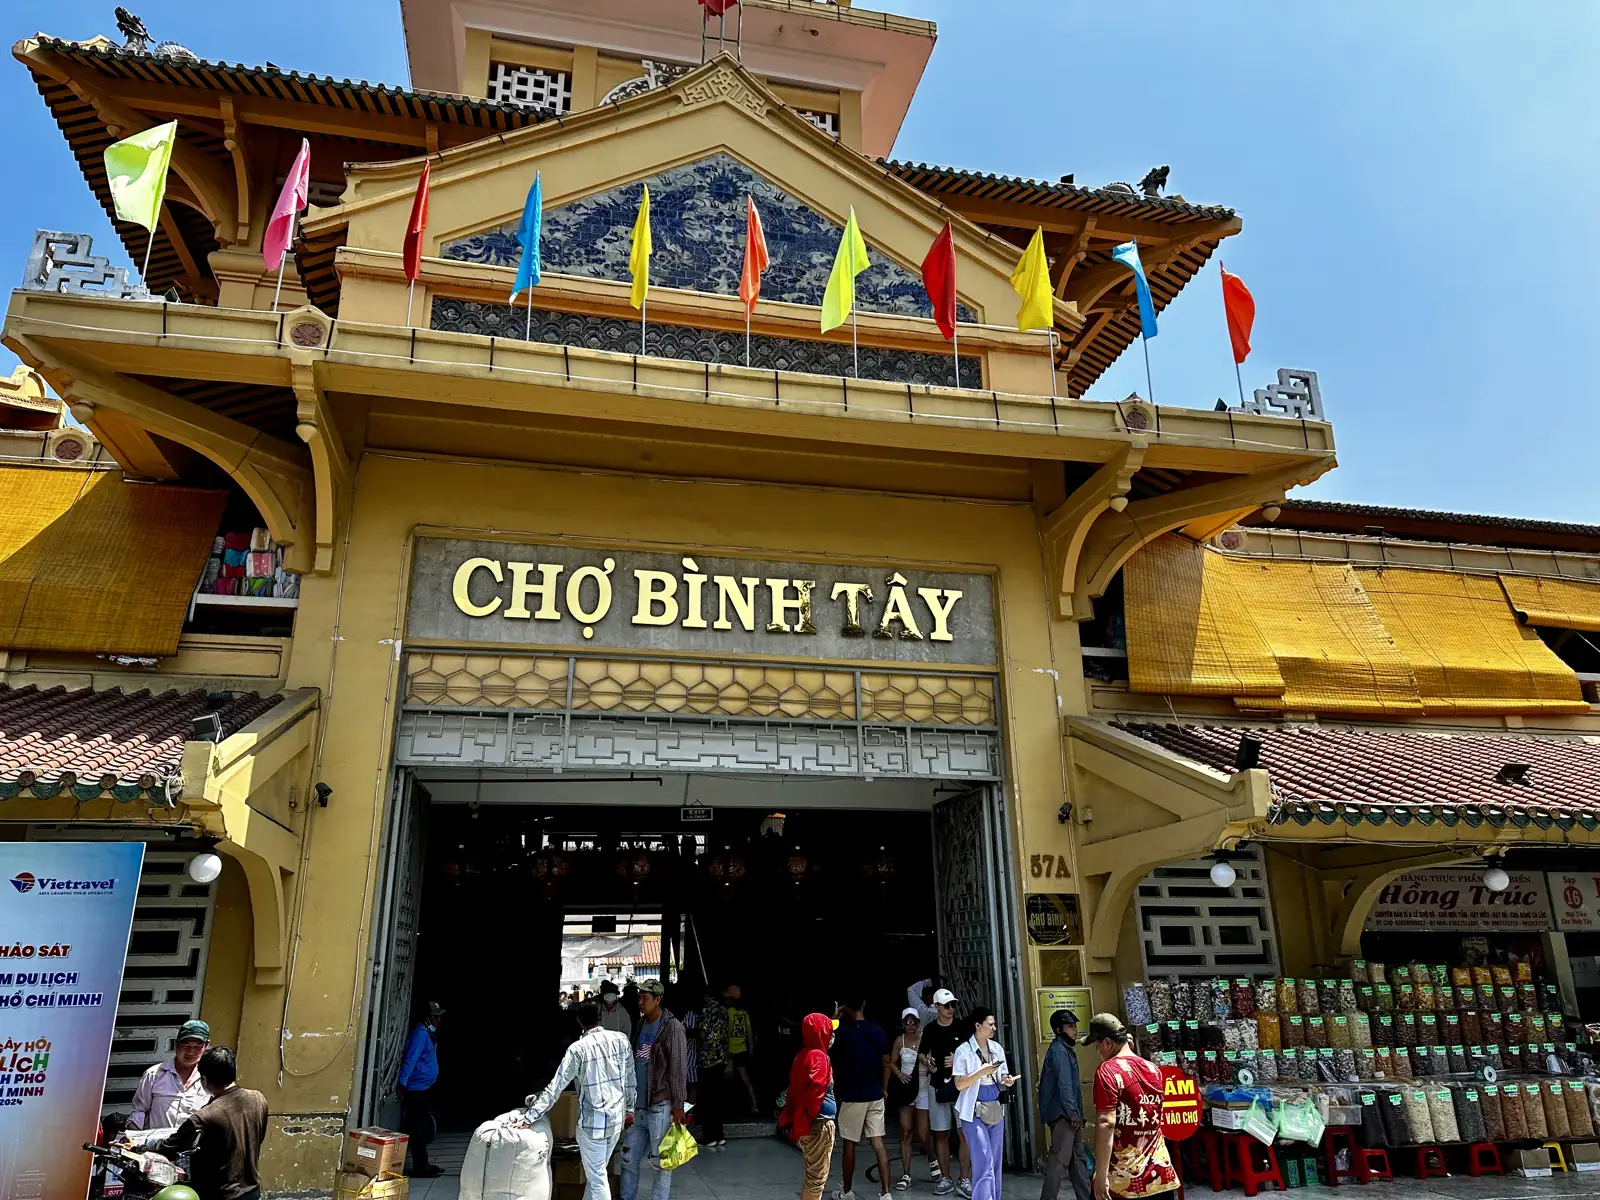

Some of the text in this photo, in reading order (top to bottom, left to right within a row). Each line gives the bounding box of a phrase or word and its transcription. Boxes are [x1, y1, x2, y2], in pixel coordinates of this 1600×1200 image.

[451, 557, 963, 642] CHỢ BÌNH TÂY
[1030, 854, 1071, 878] 57A
[37, 878, 115, 890] Vietravel
[1400, 873, 1428, 882] HÀNG
[1429, 874, 1456, 883] THỰC
[1509, 873, 1532, 883] BIẾN
[1378, 882, 1537, 910] Hồng Trúc
[1565, 889, 1581, 905] 16
[1030, 912, 1046, 929] CHỢ
[0, 942, 71, 957] HẢO SÁT
[16, 973, 38, 985] DU
[41, 972, 77, 987] LỊCH
[25, 991, 55, 1007] CHÍ
[58, 993, 102, 1006] MINH
[24, 1035, 52, 1053] HỘI
[0, 1053, 50, 1073] LỊCH
[14, 1068, 46, 1084] PHỐ
[6, 1086, 44, 1097] MINH
[1164, 1074, 1195, 1096] ẤM
[0, 1098, 23, 1106] 2024
[1138, 1094, 1161, 1105] 2024
[1165, 1109, 1182, 1125] VÀO
[1182, 1109, 1198, 1126] CHỢ
